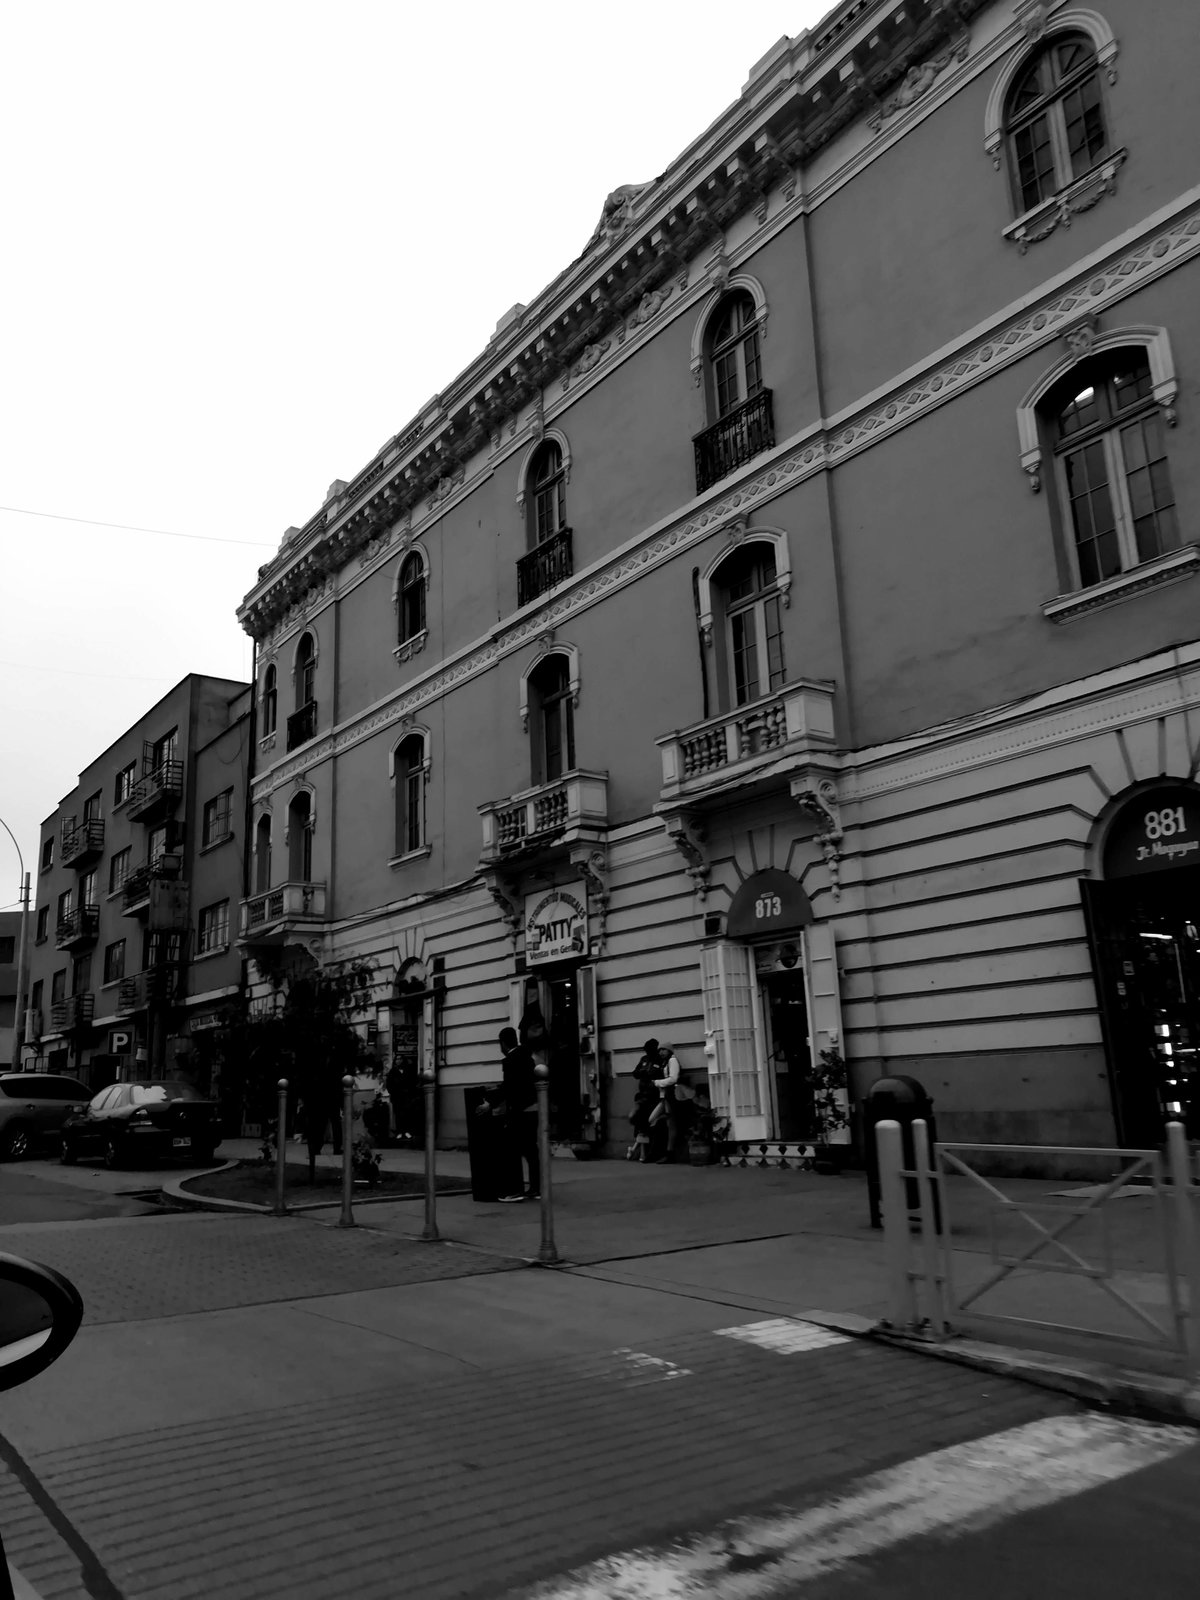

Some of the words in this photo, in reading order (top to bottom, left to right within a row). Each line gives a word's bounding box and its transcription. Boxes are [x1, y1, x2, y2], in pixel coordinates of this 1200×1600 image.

[1144, 806, 1187, 839] 881
[755, 896, 781, 918] 873
[112, 1033, 129, 1054] P
